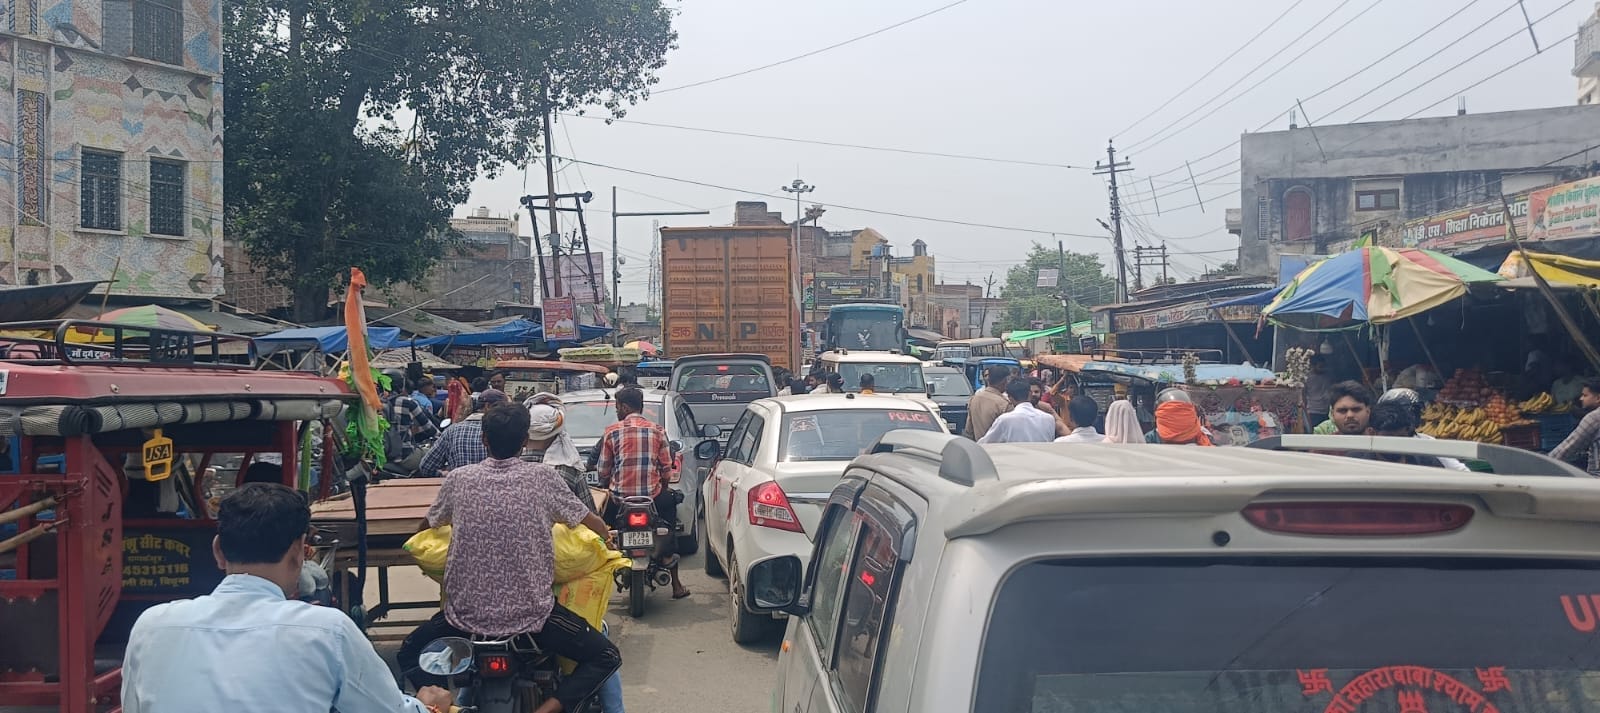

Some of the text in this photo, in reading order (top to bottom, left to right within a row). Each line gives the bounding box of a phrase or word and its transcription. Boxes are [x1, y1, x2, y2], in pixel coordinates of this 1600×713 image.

[1446, 218, 1468, 234] शिक्षा
[1469, 211, 1505, 230] निकेतन
[671, 327, 691, 338] डाक
[698, 323, 714, 340] N
[741, 322, 757, 339] P
[146, 445, 170, 461] JSA
[1341, 668, 1395, 704] सहारा
[1389, 665, 1433, 689] बाबा
[1433, 671, 1484, 713] श्याम
